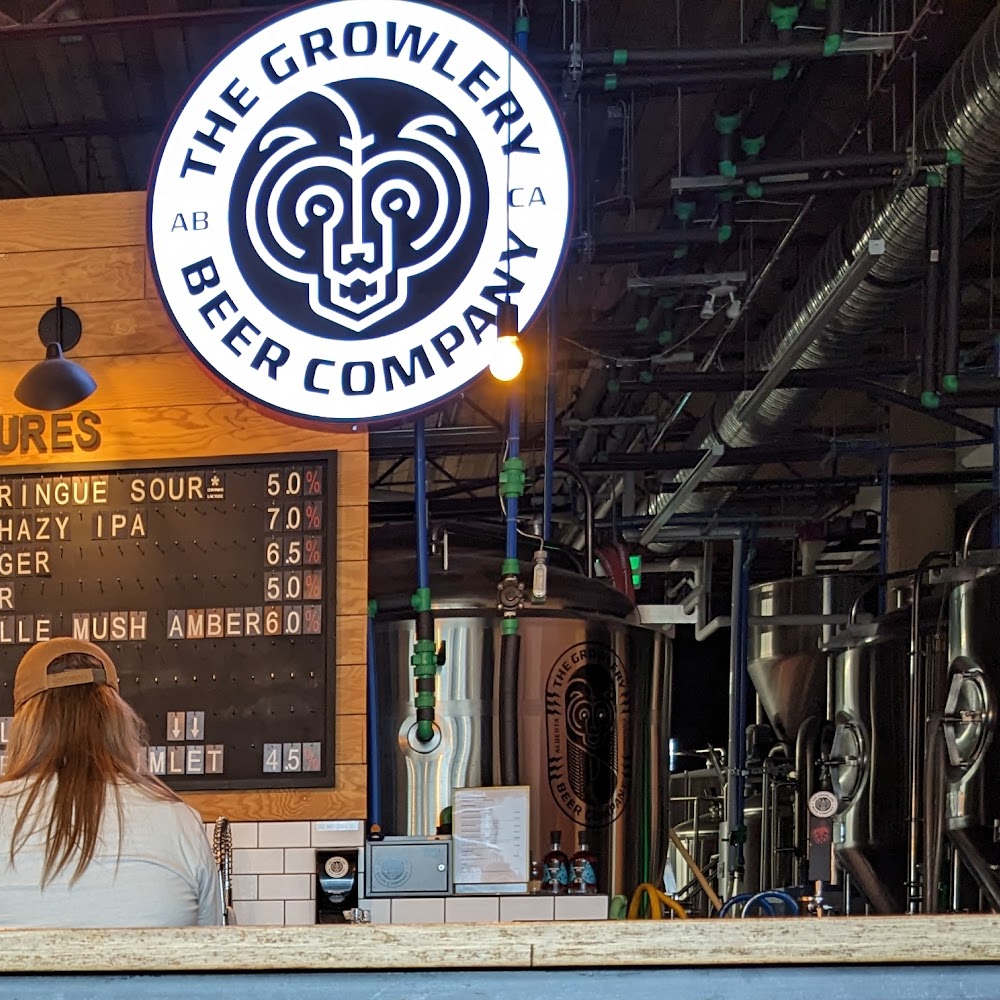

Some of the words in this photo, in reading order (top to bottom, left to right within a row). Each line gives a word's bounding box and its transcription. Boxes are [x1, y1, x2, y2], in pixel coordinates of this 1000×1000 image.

[180, 77, 260, 179] THE
[261, 20, 540, 158] GROWLERY
[509, 187, 546, 208] CA
[170, 211, 209, 233] AB
[180, 254, 291, 381] BEER
[304, 231, 539, 397] COMPANY
[97, 513, 146, 538] IPA
[73, 616, 146, 640] MUSH
[169, 612, 260, 637] AMBER
[554, 660, 571, 688] THE
[137, 750, 221, 774] MLET
[556, 783, 583, 816] BEER
